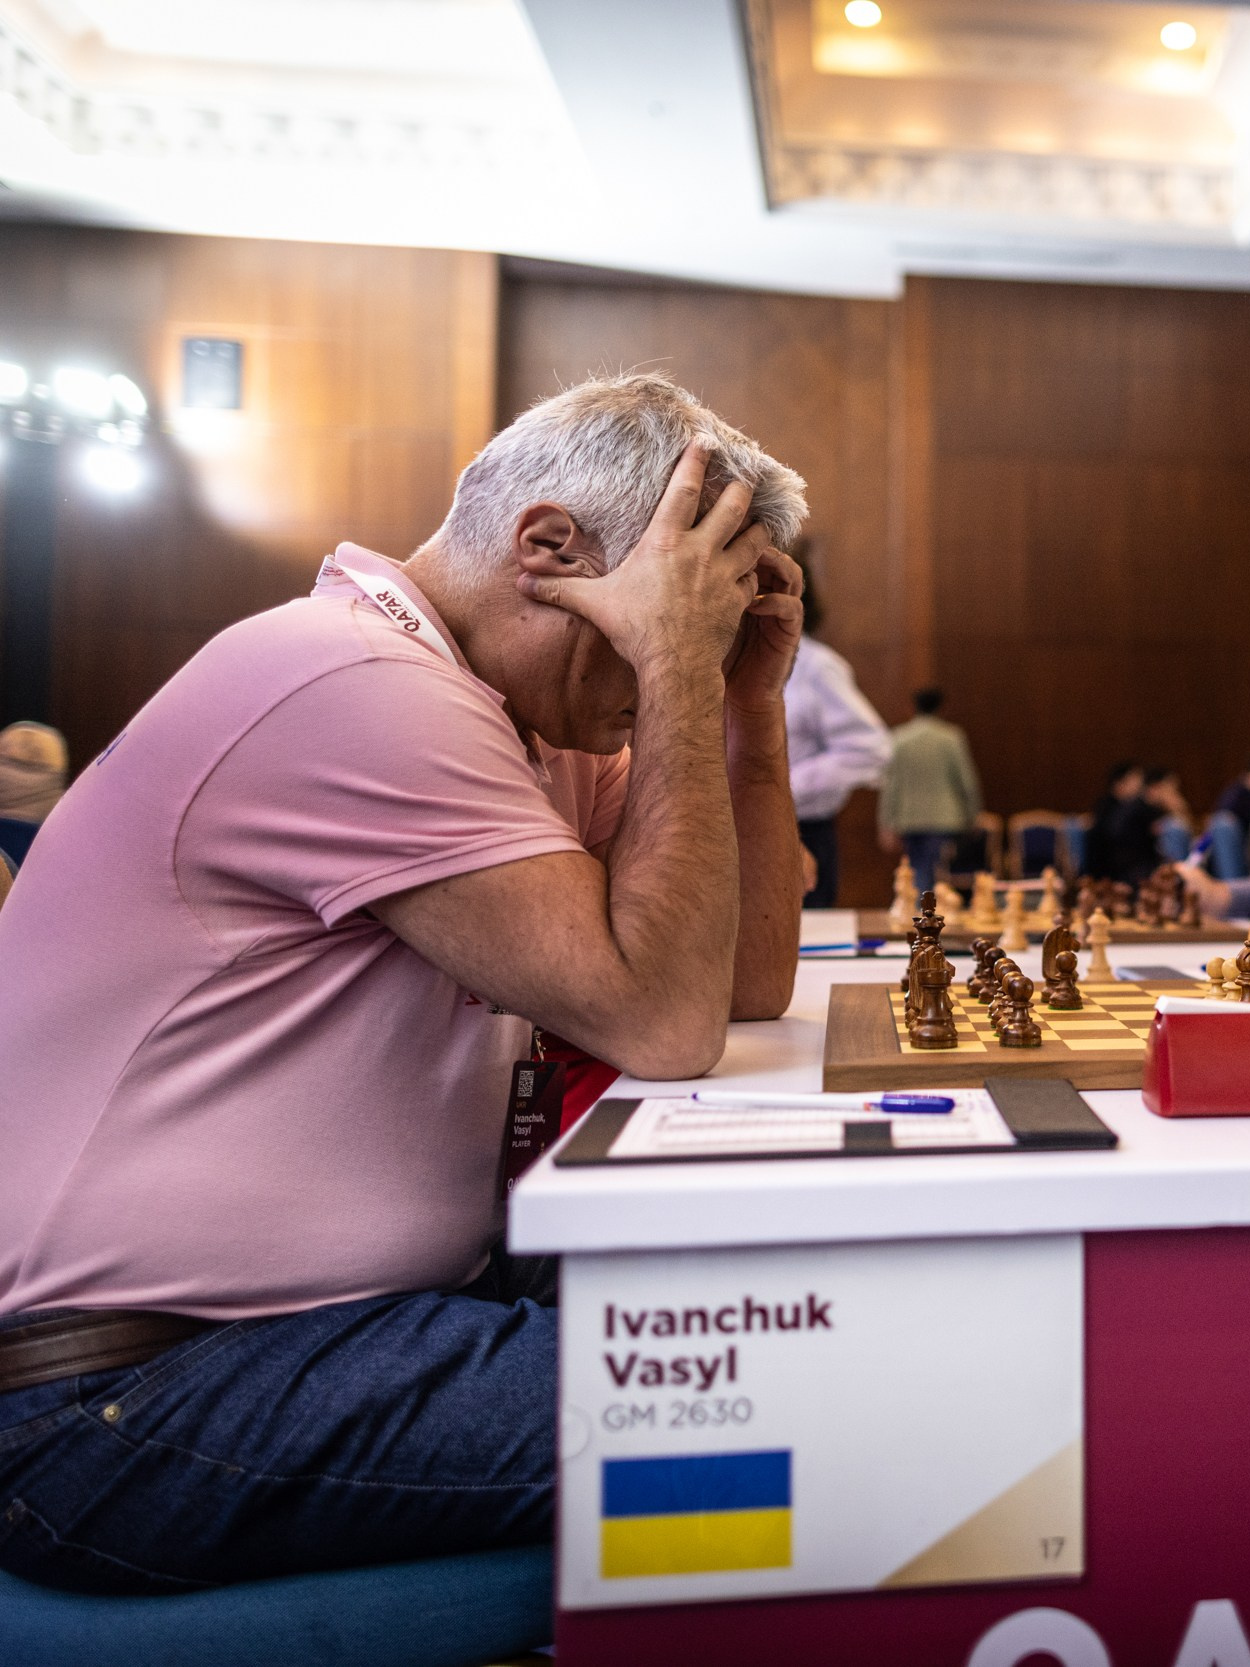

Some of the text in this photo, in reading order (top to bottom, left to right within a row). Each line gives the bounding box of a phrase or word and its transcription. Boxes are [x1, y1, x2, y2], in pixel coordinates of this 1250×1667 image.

[375, 590, 421, 633] QATAR
[513, 1124, 532, 1136] Vasyl
[514, 1112, 546, 1125] Ivanchuk,
[511, 1140, 531, 1148] PLAYER
[604, 1293, 833, 1340] Ivanchuk
[603, 1345, 738, 1392] Vasyl
[601, 1397, 753, 1432] GM 2630
[1040, 1535, 1066, 1560] 17
